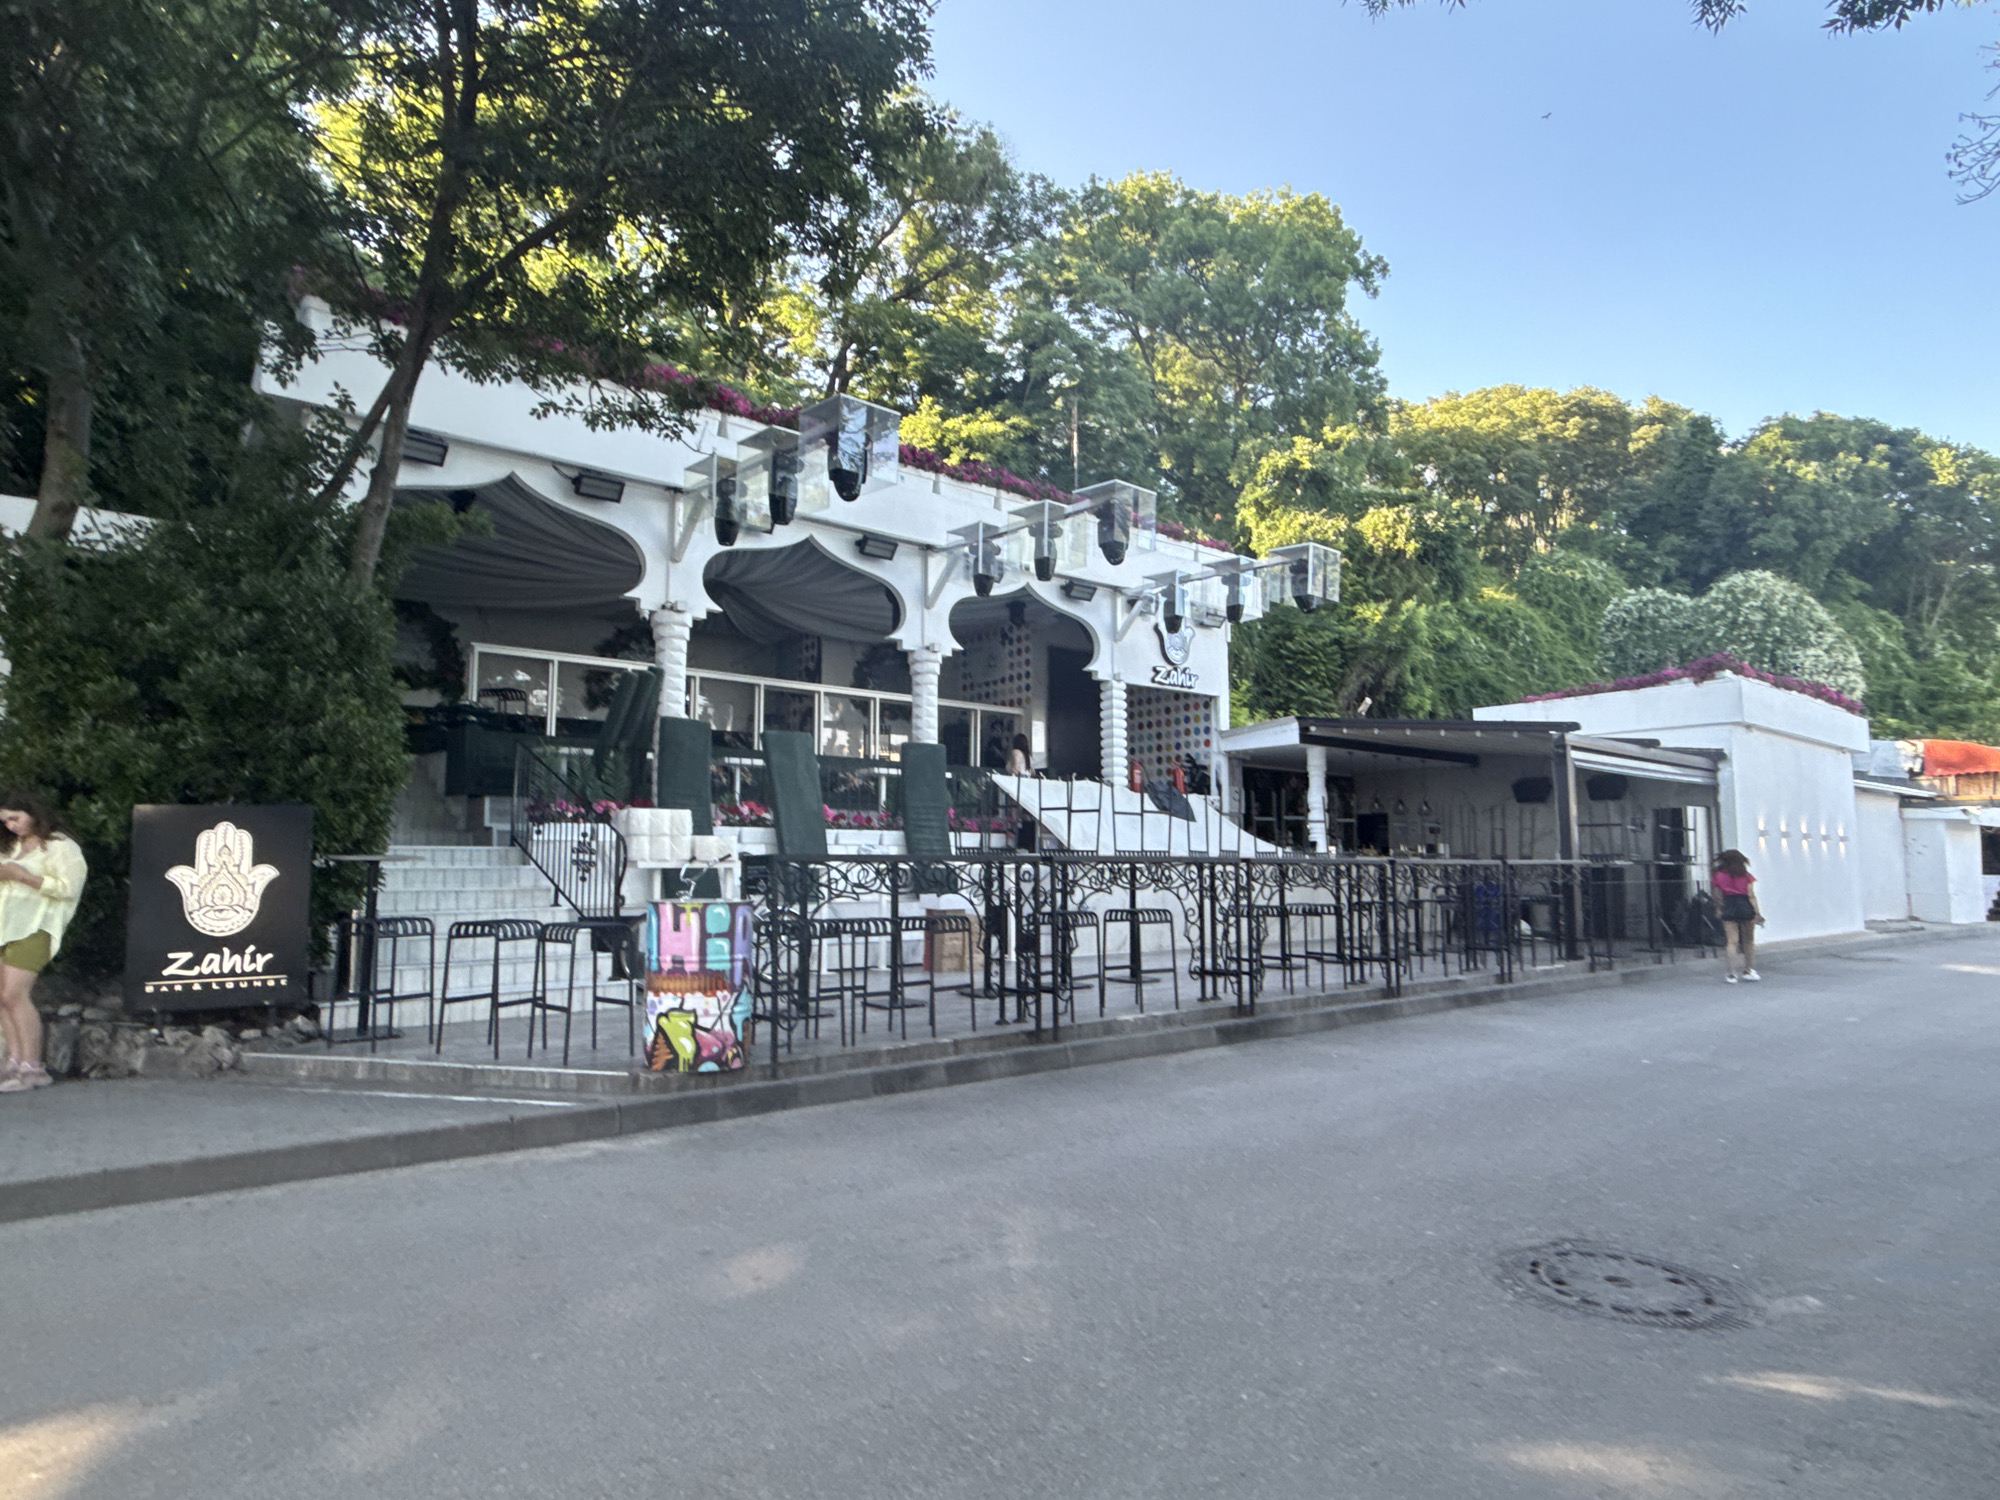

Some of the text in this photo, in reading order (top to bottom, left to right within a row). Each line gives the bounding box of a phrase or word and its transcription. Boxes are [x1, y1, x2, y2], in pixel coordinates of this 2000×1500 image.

[144, 978, 288, 994] BAR & LOUNGE
